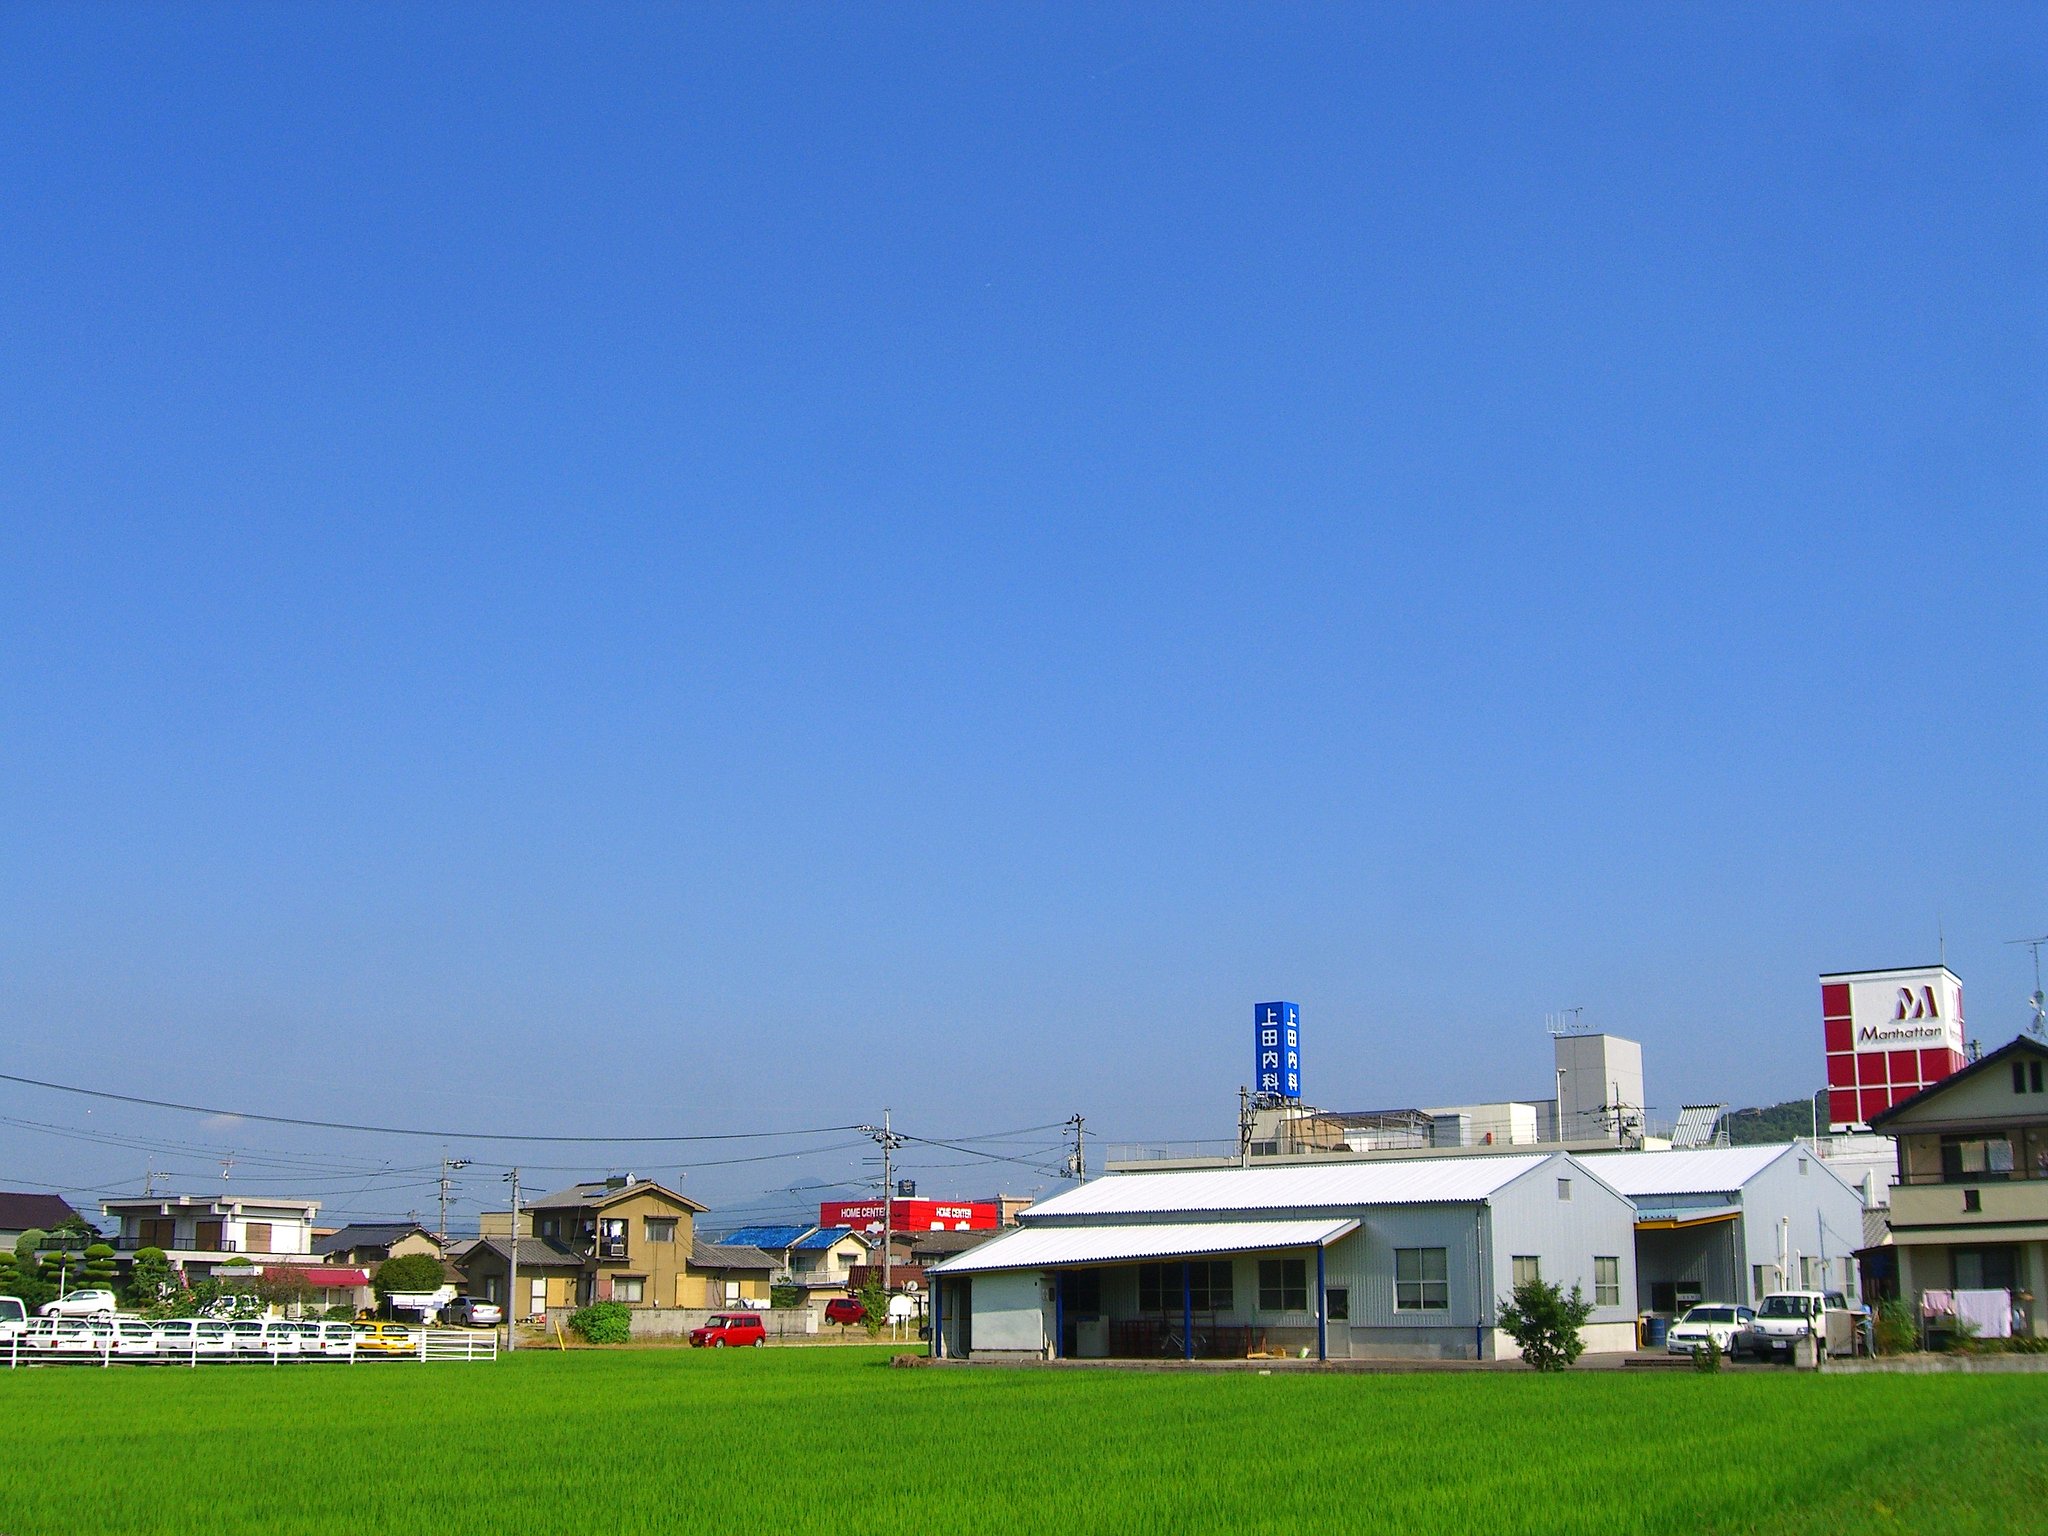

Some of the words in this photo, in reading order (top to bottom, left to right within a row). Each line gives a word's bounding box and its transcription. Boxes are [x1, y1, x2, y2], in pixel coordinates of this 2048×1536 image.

[1860, 1025, 1942, 1041] Manhattan
[1261, 1008, 1279, 1091] 上田内科
[1286, 1008, 1298, 1091] 上田内科
[841, 1207, 861, 1218] HOME
[861, 1207, 886, 1218] CENTE
[936, 1207, 951, 1218] HOME
[951, 1207, 972, 1219] CENTER
